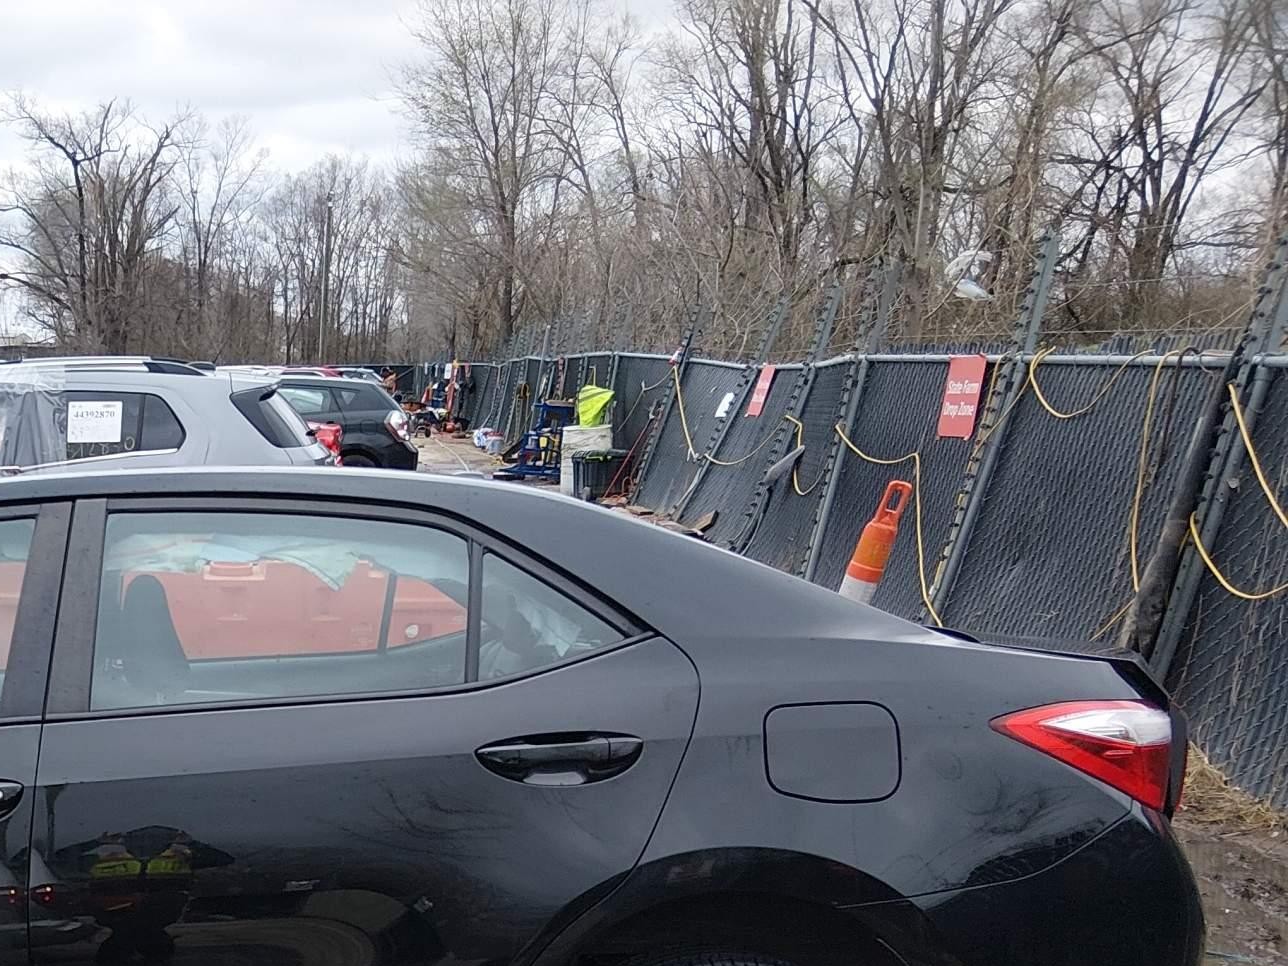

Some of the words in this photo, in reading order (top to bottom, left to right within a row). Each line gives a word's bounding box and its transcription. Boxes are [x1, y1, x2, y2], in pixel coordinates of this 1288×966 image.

[946, 380, 963, 394] State
[963, 379, 980, 394] Farm
[943, 402, 958, 418] Drop
[957, 402, 974, 416] Zone
